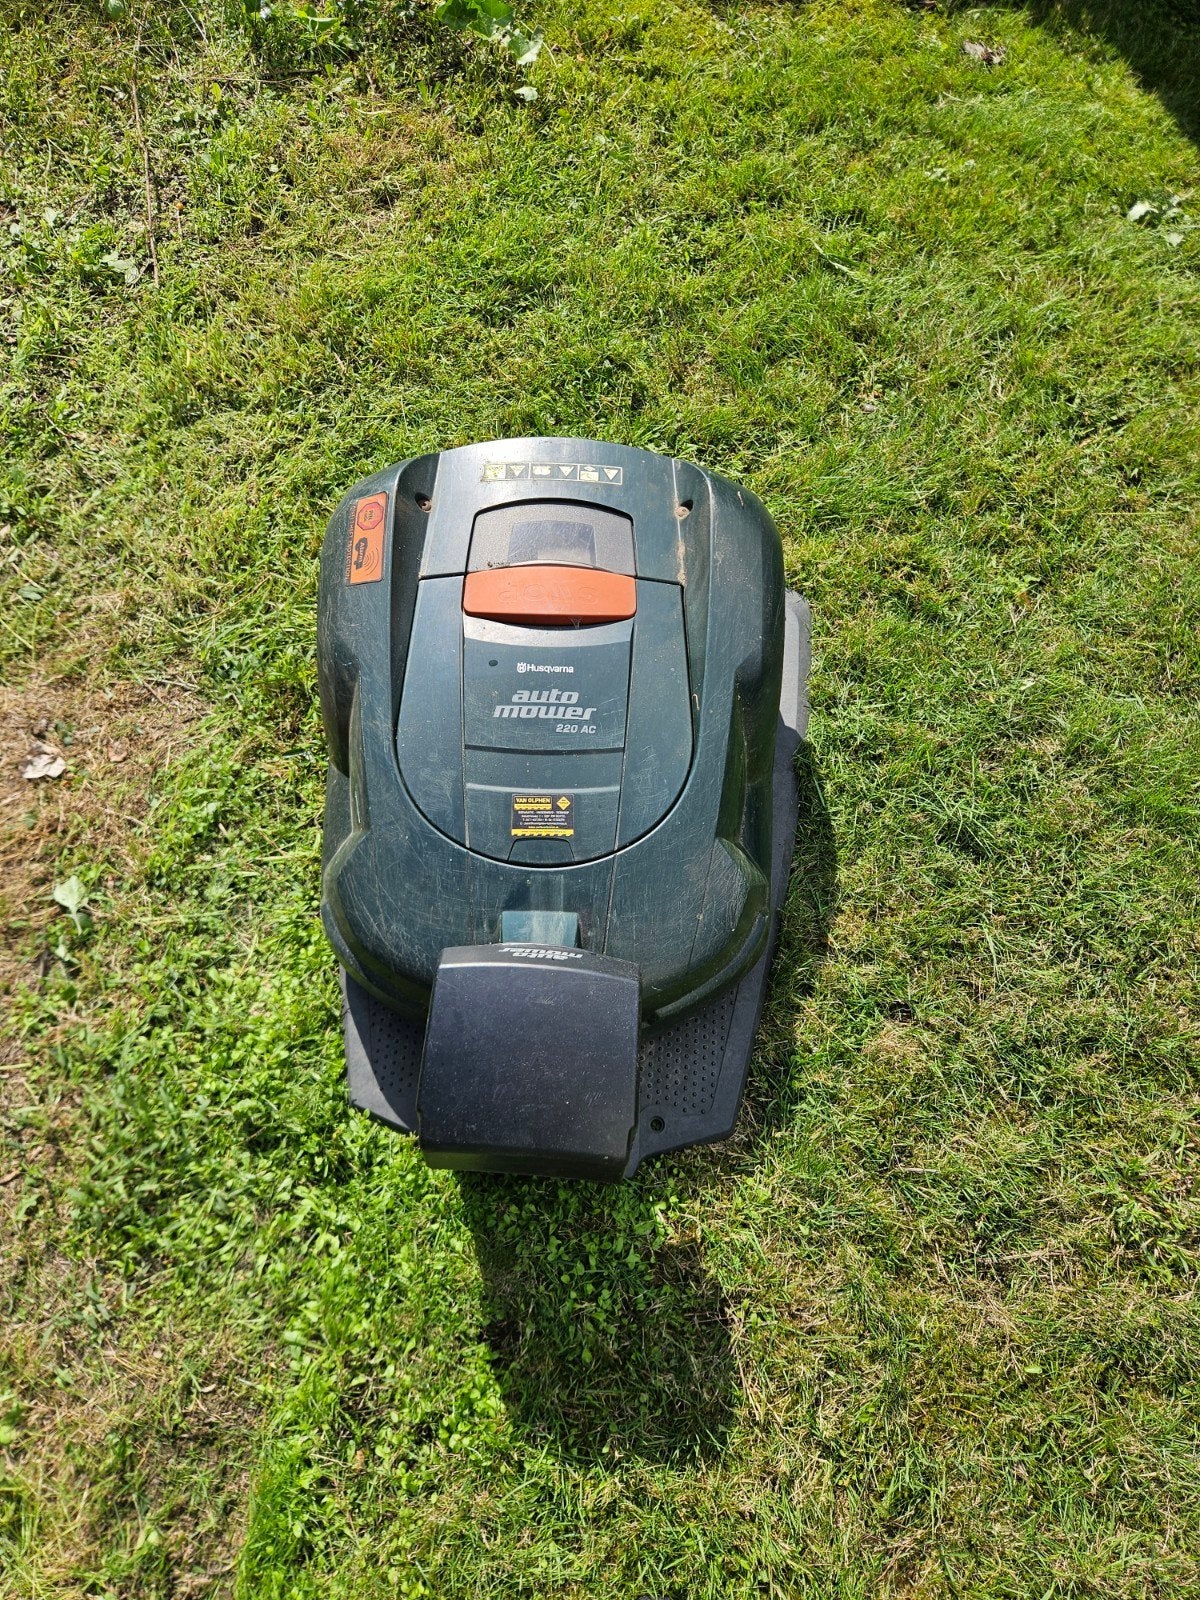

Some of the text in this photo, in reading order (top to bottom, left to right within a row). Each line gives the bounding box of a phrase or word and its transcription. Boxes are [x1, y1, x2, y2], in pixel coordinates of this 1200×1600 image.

[527, 663, 574, 674] Husqvarna
[511, 688, 579, 704] auto
[493, 705, 597, 721] mower
[556, 723, 597, 734] 220 AC
